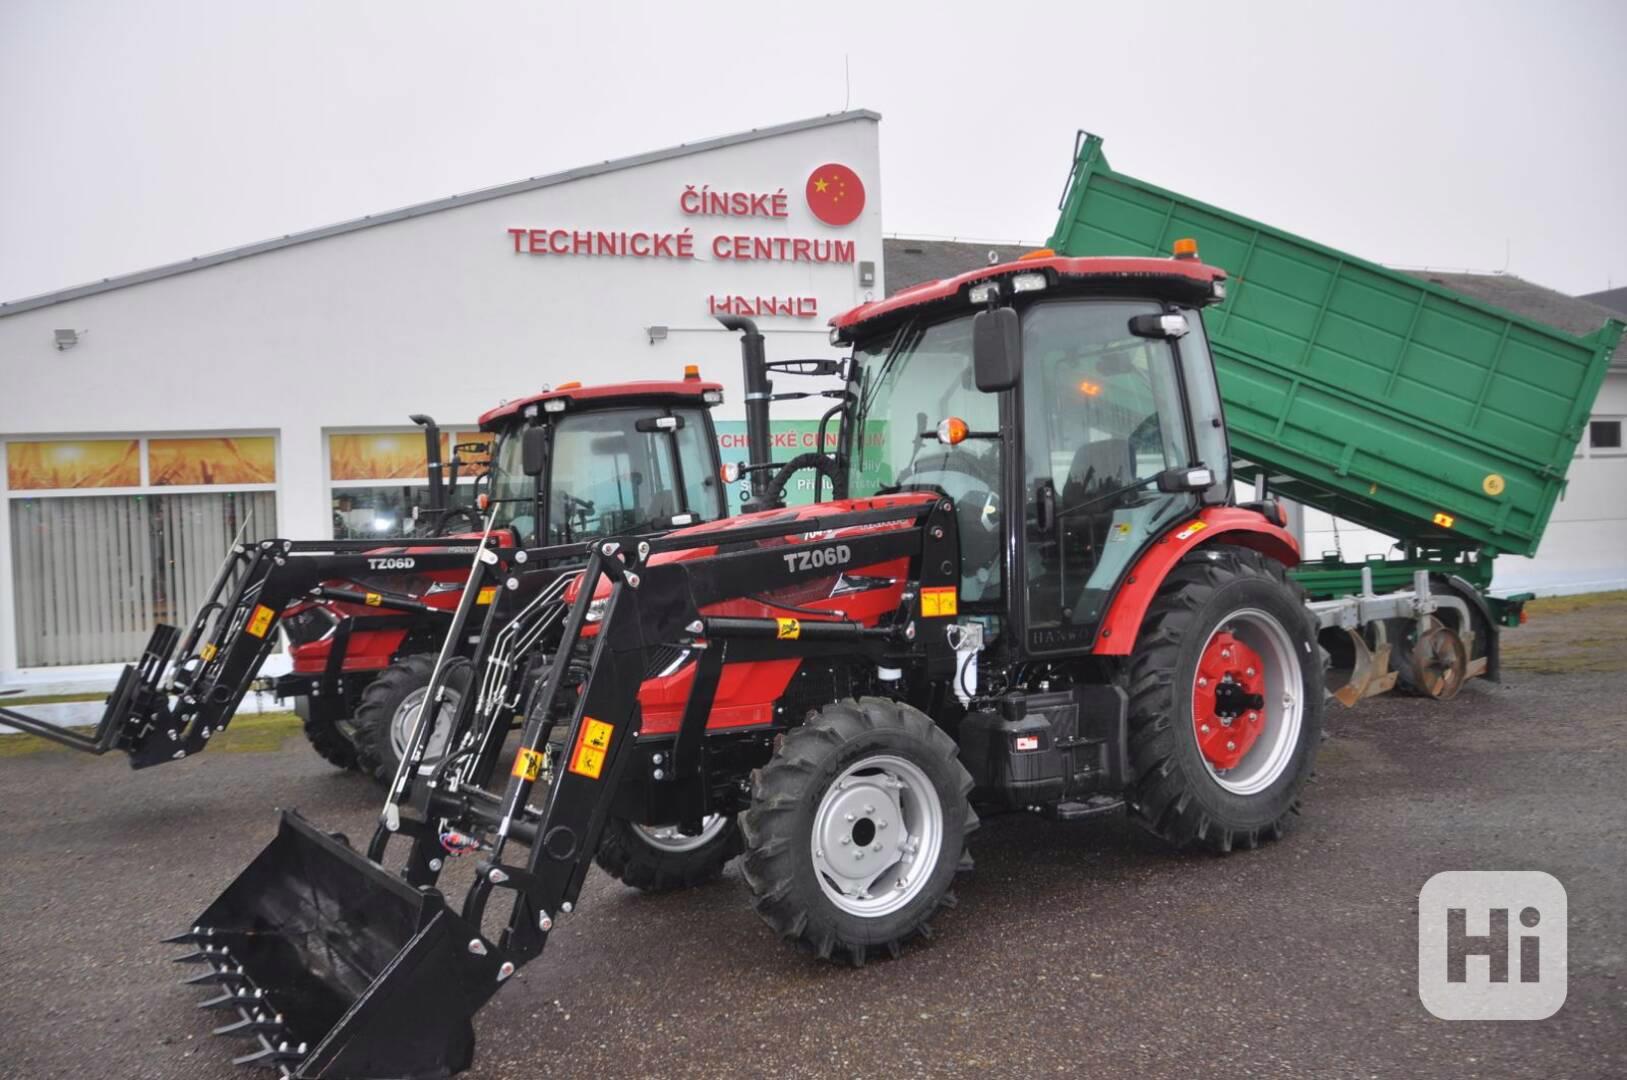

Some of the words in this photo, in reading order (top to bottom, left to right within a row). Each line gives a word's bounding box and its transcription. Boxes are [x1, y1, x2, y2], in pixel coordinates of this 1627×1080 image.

[680, 185, 788, 217] ČÍNSKÉ
[507, 228, 694, 258] TECHNICKÉ
[712, 236, 855, 263] CENTRUM
[368, 558, 415, 570] TZ06D
[784, 545, 850, 573] TZ06D
